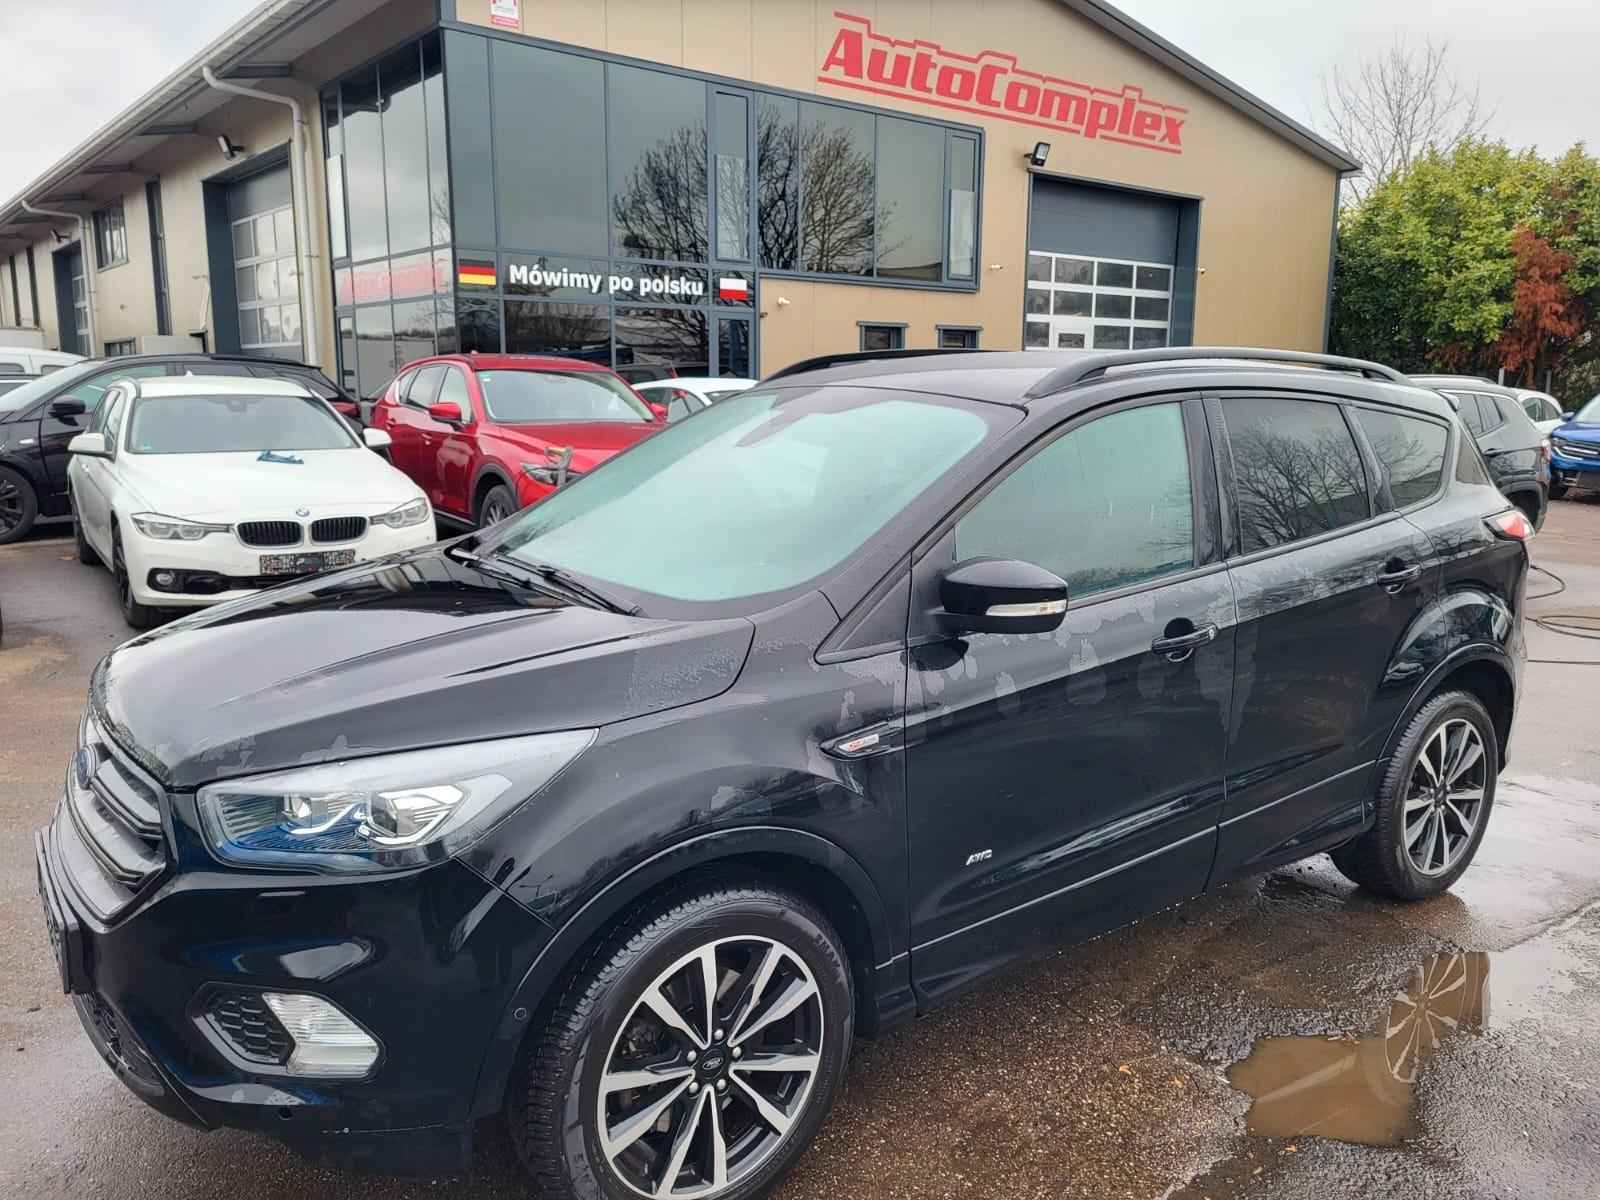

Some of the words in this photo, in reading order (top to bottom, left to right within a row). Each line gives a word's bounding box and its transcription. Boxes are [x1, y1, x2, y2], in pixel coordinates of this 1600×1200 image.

[822, 28, 1185, 145] AutoComplex
[509, 264, 602, 292] Mówimy
[608, 275, 634, 294] po
[640, 275, 704, 296] polsku
